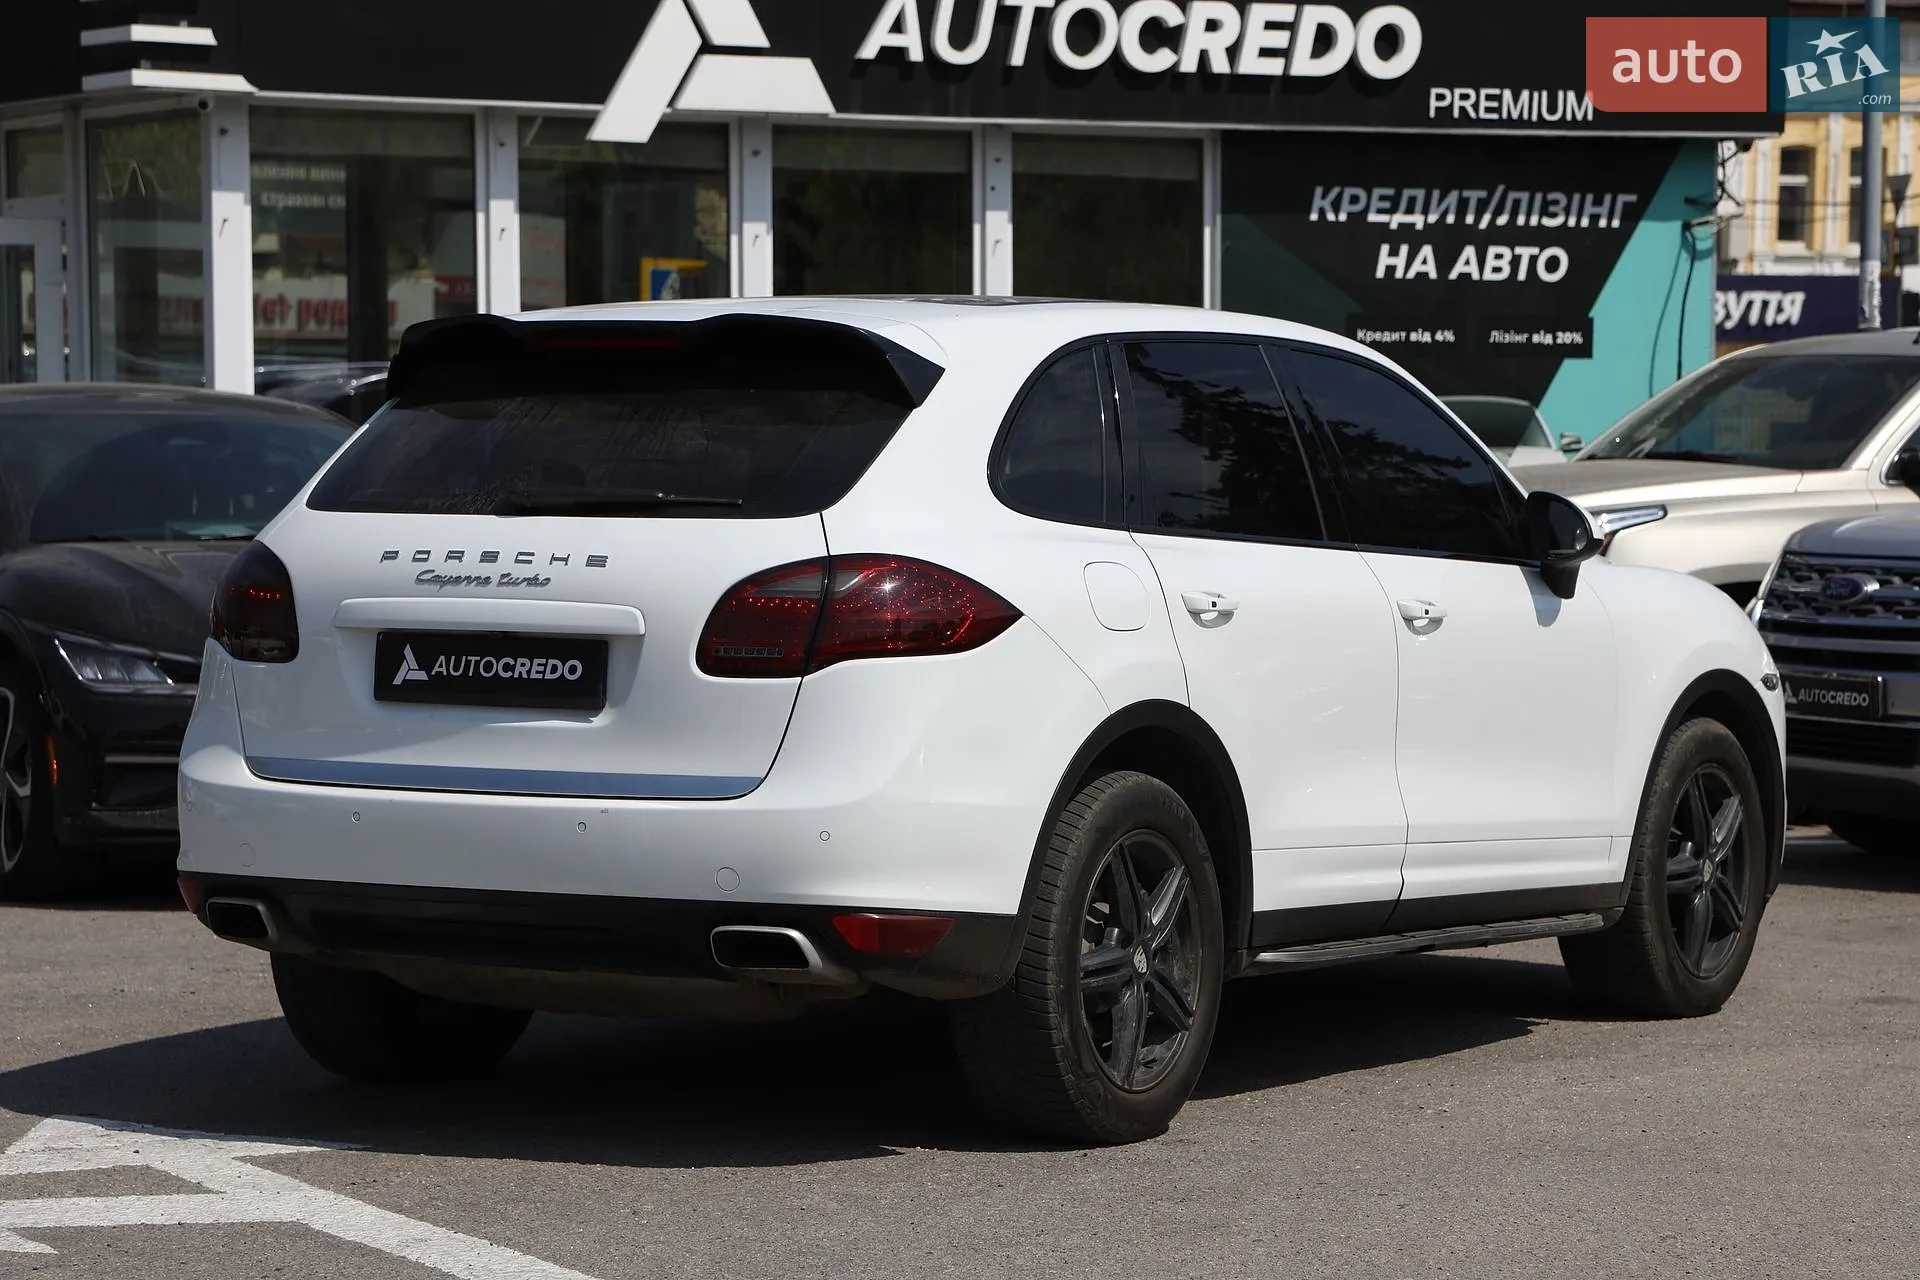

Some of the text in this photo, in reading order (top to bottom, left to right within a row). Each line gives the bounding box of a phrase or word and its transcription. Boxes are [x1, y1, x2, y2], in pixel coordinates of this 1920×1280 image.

[855, 0, 1422, 80] AUTOCREDO
[1428, 87, 1594, 122] PREMIUM
[1308, 184, 1637, 230] КРЕДИТ/ЛІЗІНГ
[1375, 243, 1569, 283] НА АВТО
[1356, 328, 1456, 343] Кредит від 4%
[1488, 330, 1584, 344] Лізінг від 20%
[379, 550, 608, 568] PORSCHE
[415, 569, 493, 592] Cayenne
[431, 655, 583, 681] AUTOCREDO
[1798, 688, 1869, 707] AUTOCREDO
